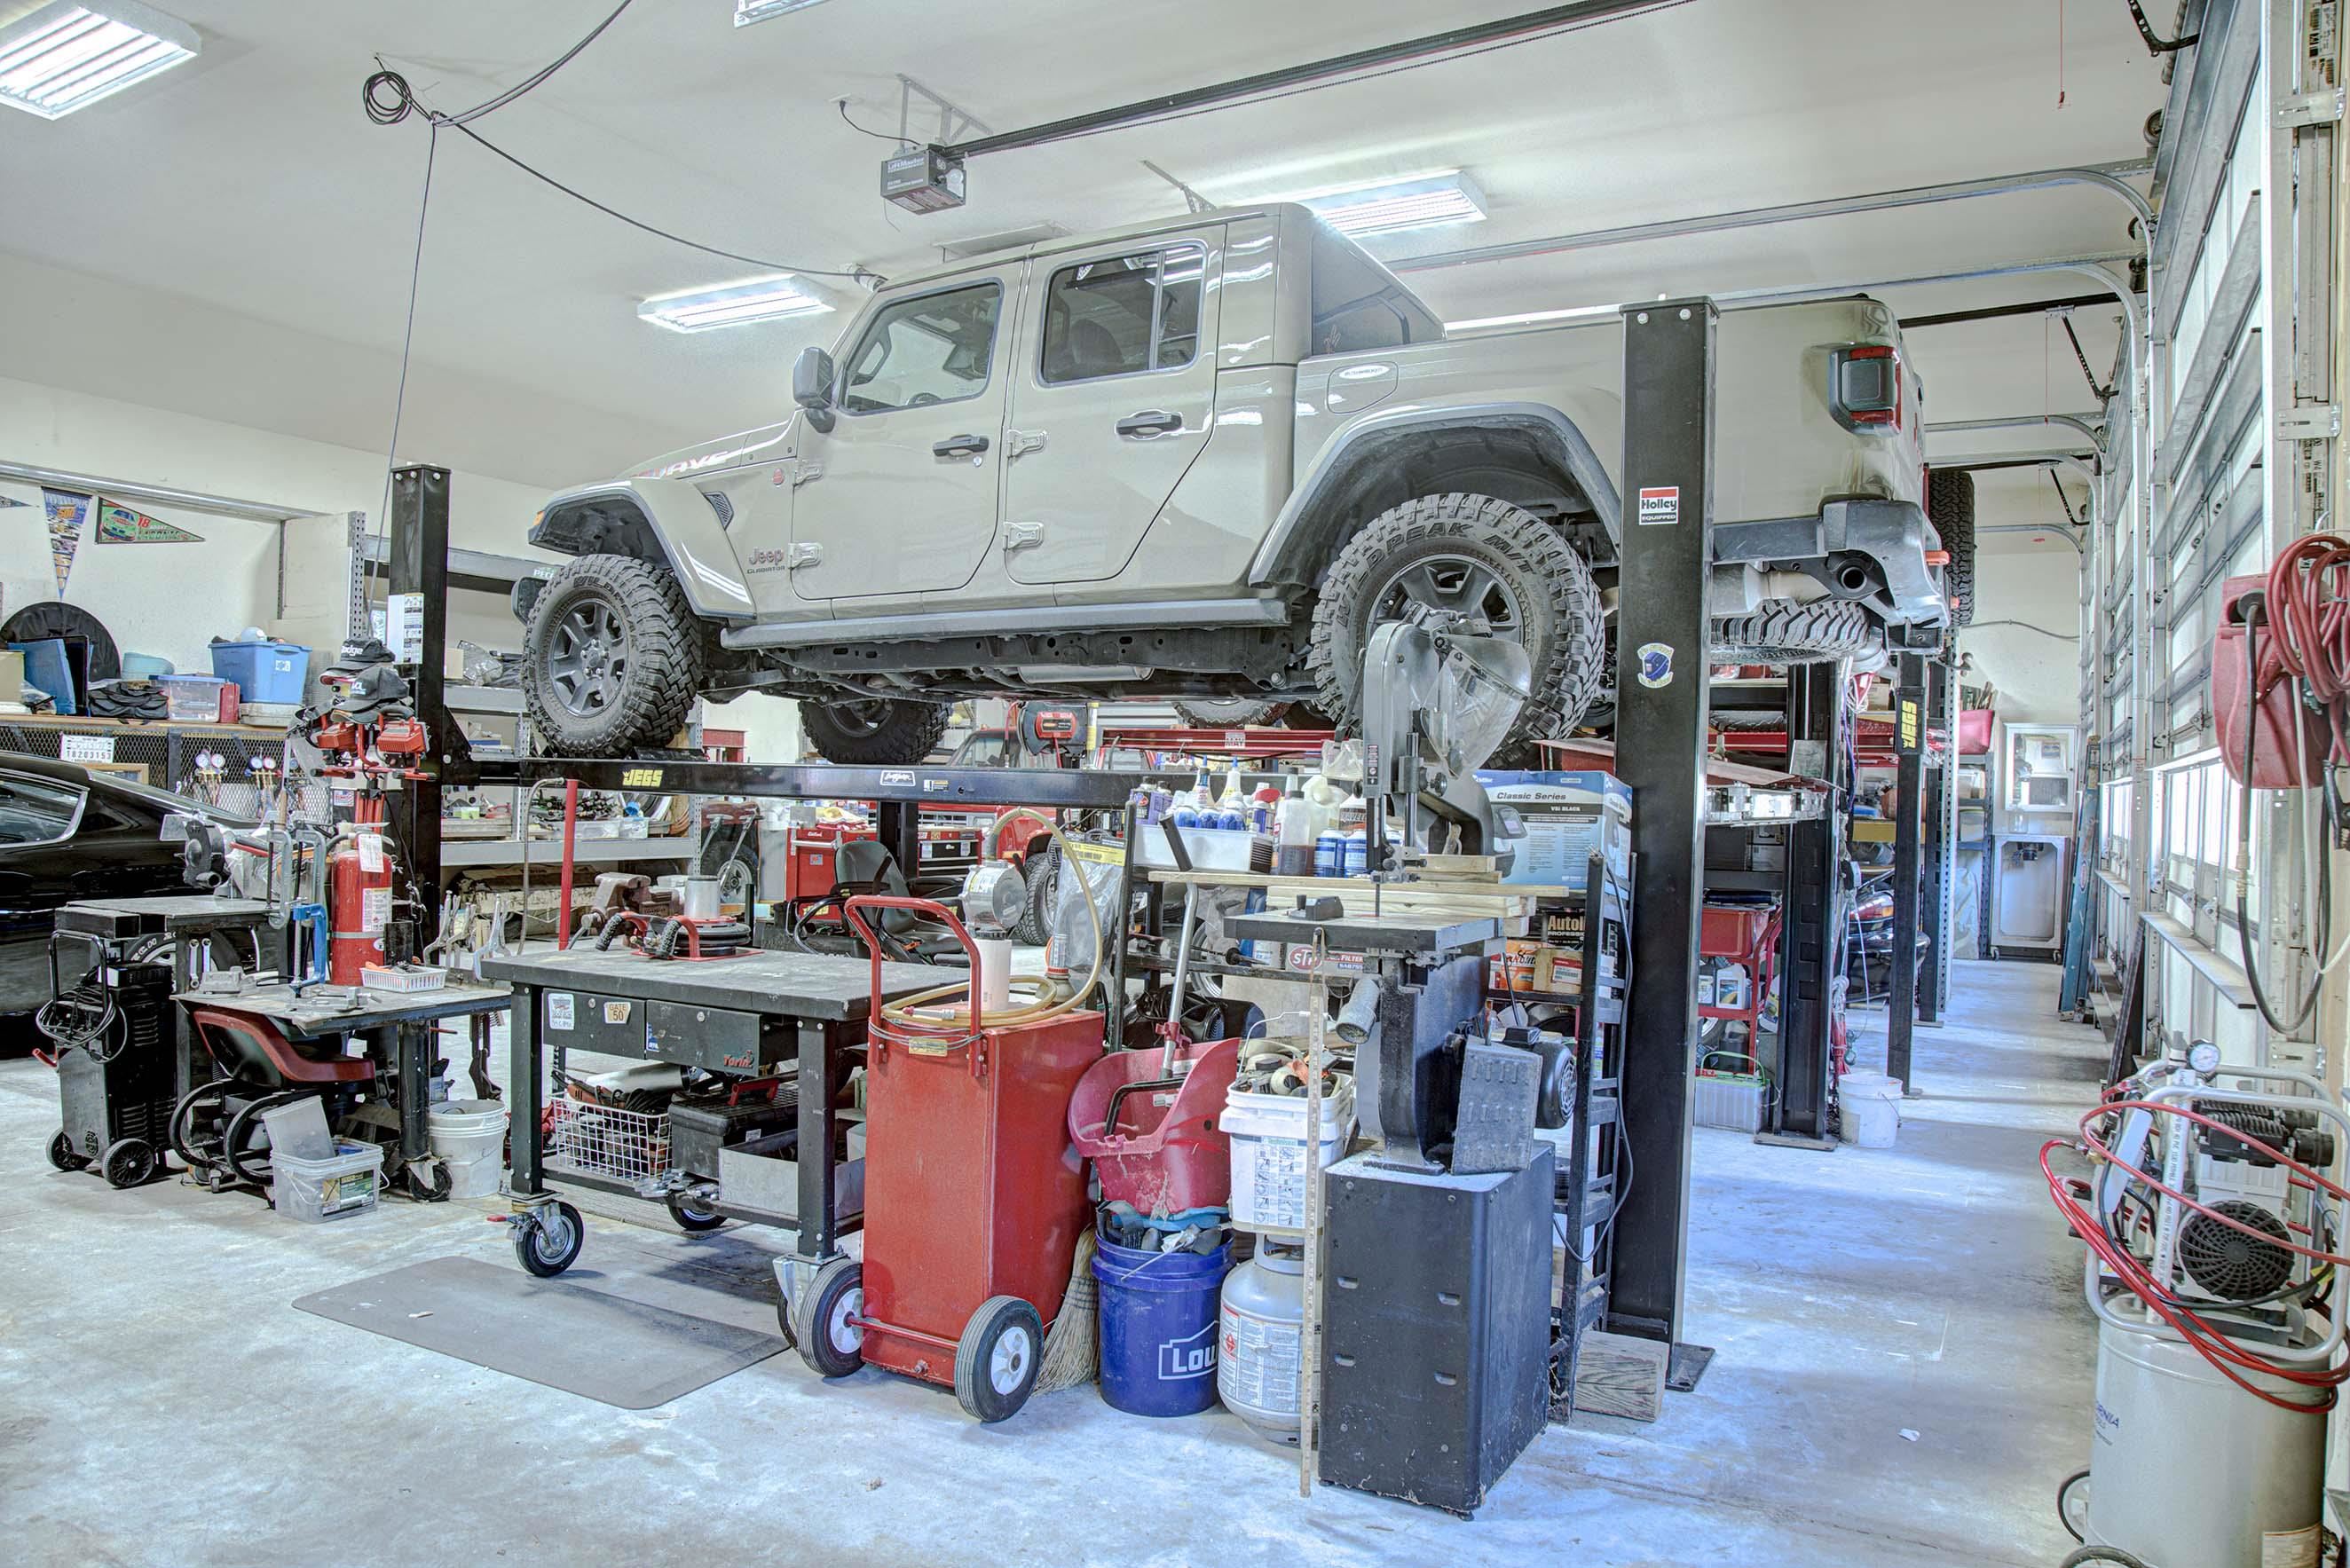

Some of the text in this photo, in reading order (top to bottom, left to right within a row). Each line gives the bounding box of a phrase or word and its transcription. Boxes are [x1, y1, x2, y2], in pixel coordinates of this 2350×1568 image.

[1641, 499, 1677, 511] Holley
[138, 516, 151, 528] 18
[748, 547, 785, 566] Jeep
[746, 565, 785, 574] GLADIATOR
[1337, 522, 1473, 628] WILDPEAK
[1901, 699, 1918, 749] JEGS
[622, 768, 664, 788] JEGS
[612, 1011, 624, 1021] 50
